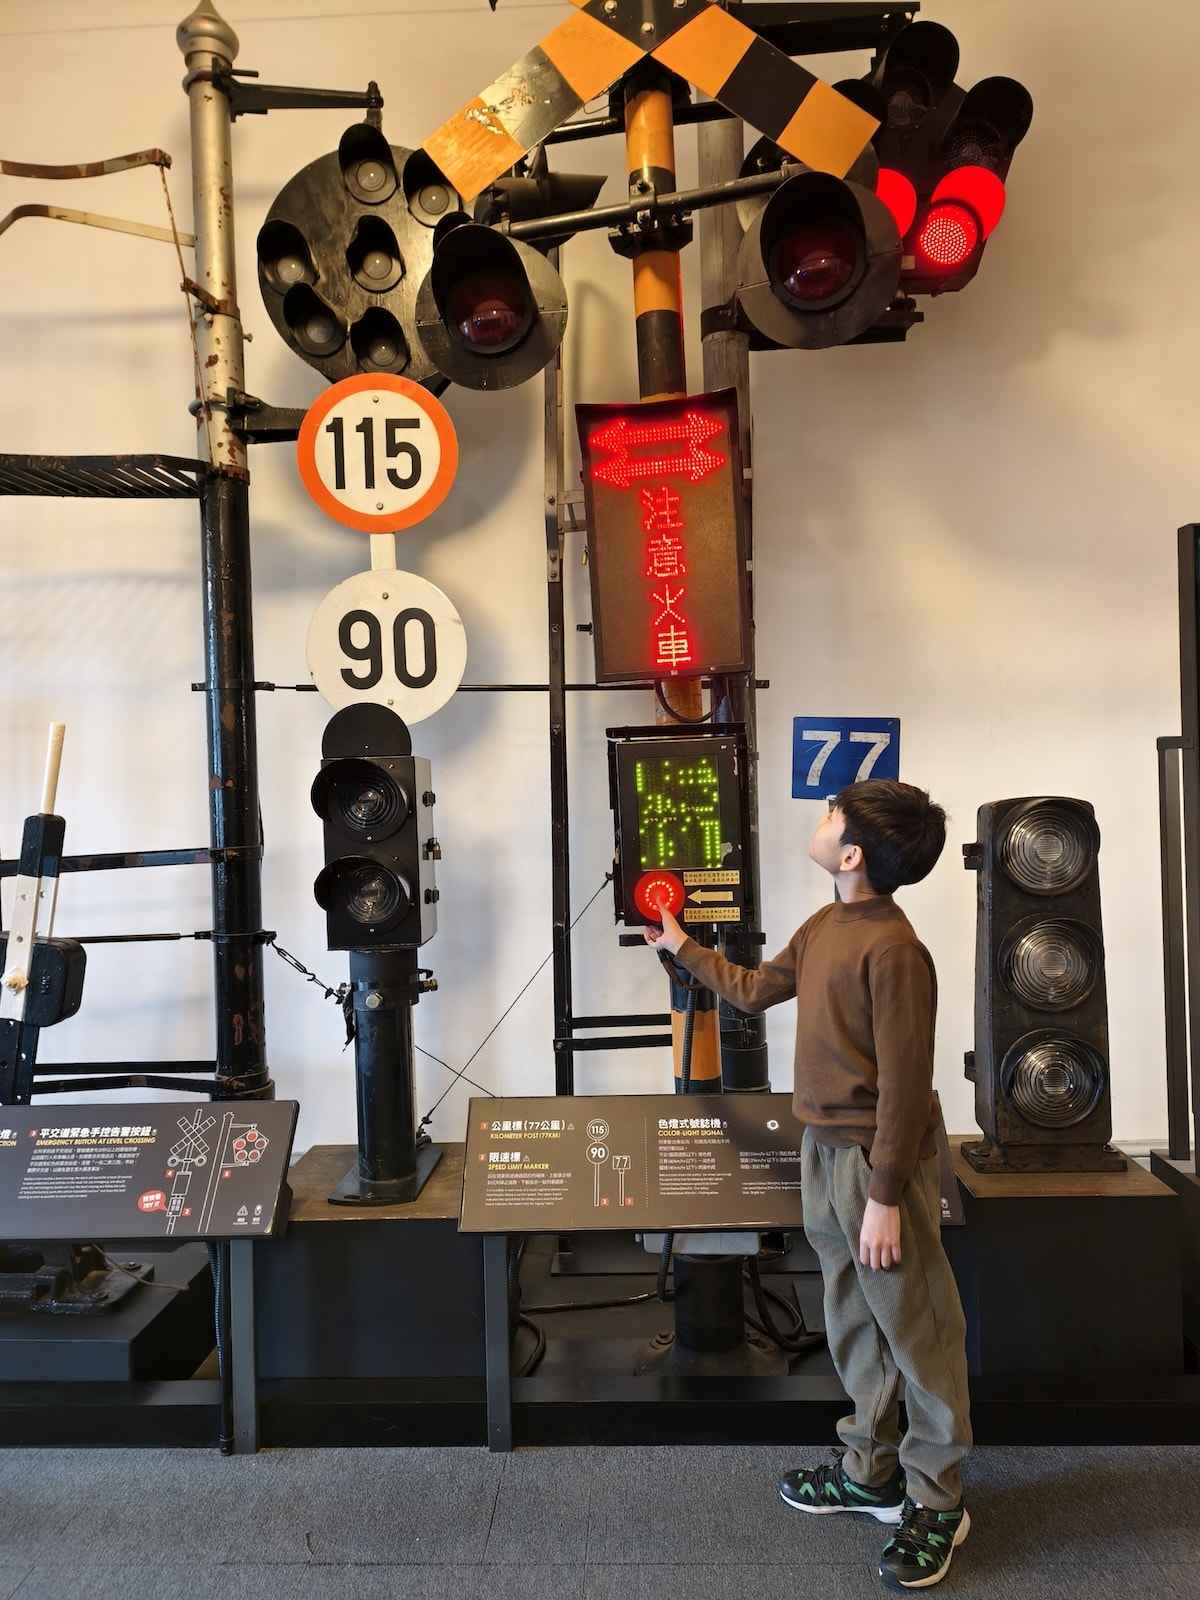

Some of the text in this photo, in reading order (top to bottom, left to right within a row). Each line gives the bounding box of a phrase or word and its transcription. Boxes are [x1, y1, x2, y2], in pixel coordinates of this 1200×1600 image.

[325, 416, 422, 490] 115
[642, 486, 692, 667] 注意火車
[338, 607, 438, 690] 90
[801, 730, 891, 787] 77
[591, 1125, 605, 1135] 115
[75, 1138, 97, 1146] BUTTON
[124, 1137, 156, 1145] CROSSING
[490, 1132, 522, 1140] KILOMETER
[488, 1152, 521, 1163] 限速標
[590, 1147, 606, 1159] 90
[488, 1163, 506, 1171] SPEED
[615, 1157, 629, 1168] 77
